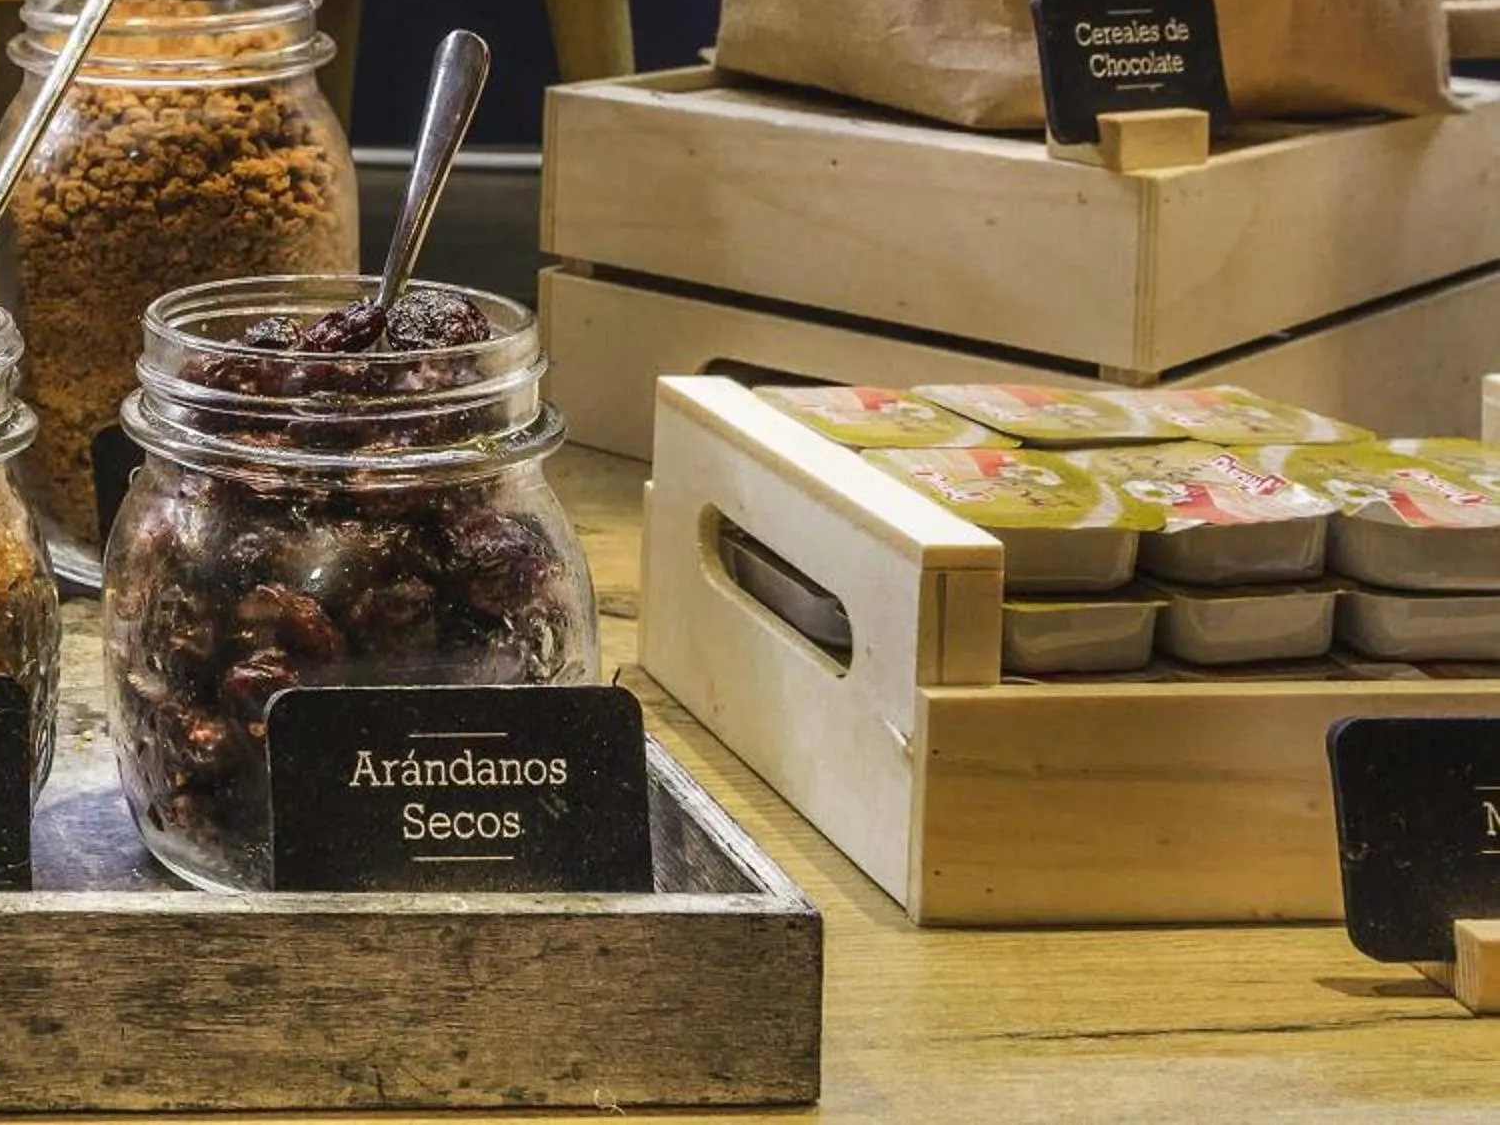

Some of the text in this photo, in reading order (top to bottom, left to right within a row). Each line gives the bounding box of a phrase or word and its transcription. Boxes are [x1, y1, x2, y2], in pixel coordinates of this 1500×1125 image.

[1075, 17, 1189, 46] Cereales de
[1089, 49, 1185, 78] Chocolate
[348, 749, 568, 788] Arándanos
[402, 803, 522, 840] Secos
